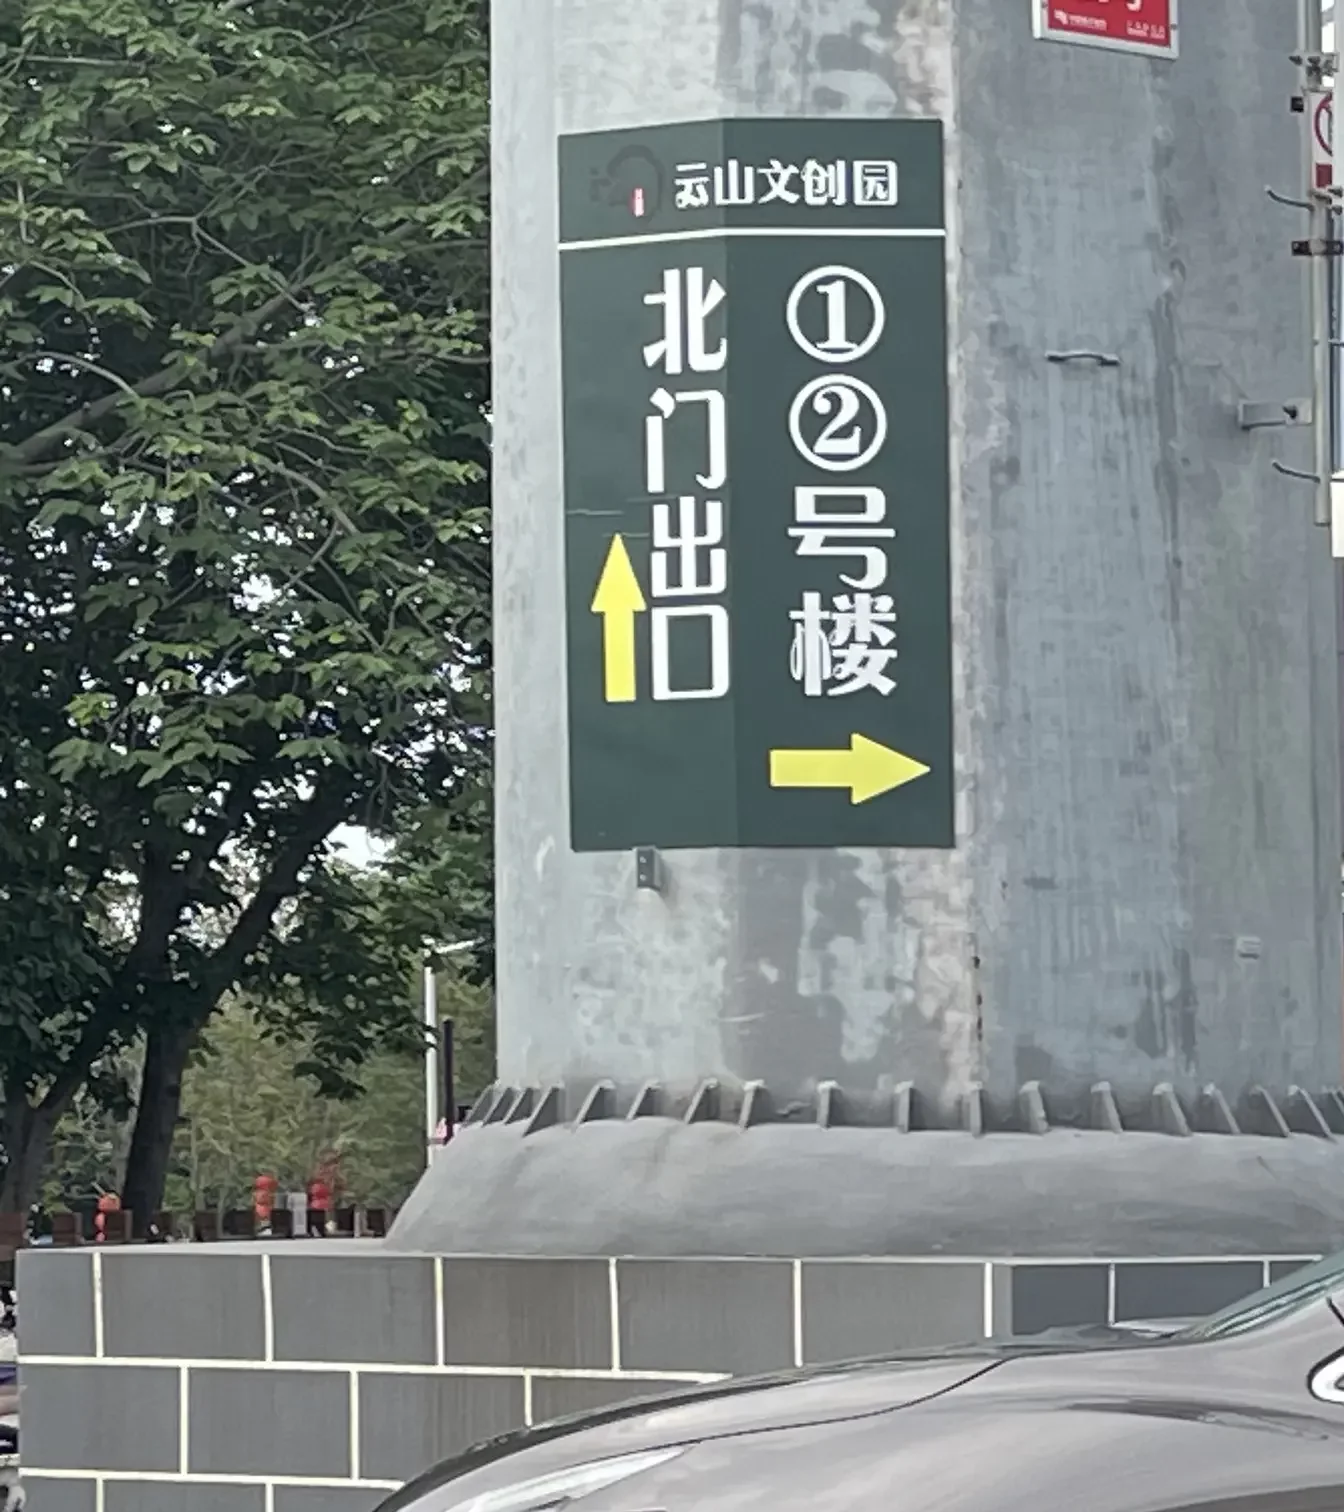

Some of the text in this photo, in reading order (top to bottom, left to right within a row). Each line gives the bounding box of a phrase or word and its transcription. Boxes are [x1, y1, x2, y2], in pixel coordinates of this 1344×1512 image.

[674, 159, 898, 208] 云山文创园
[642, 266, 730, 701] 北门出口
